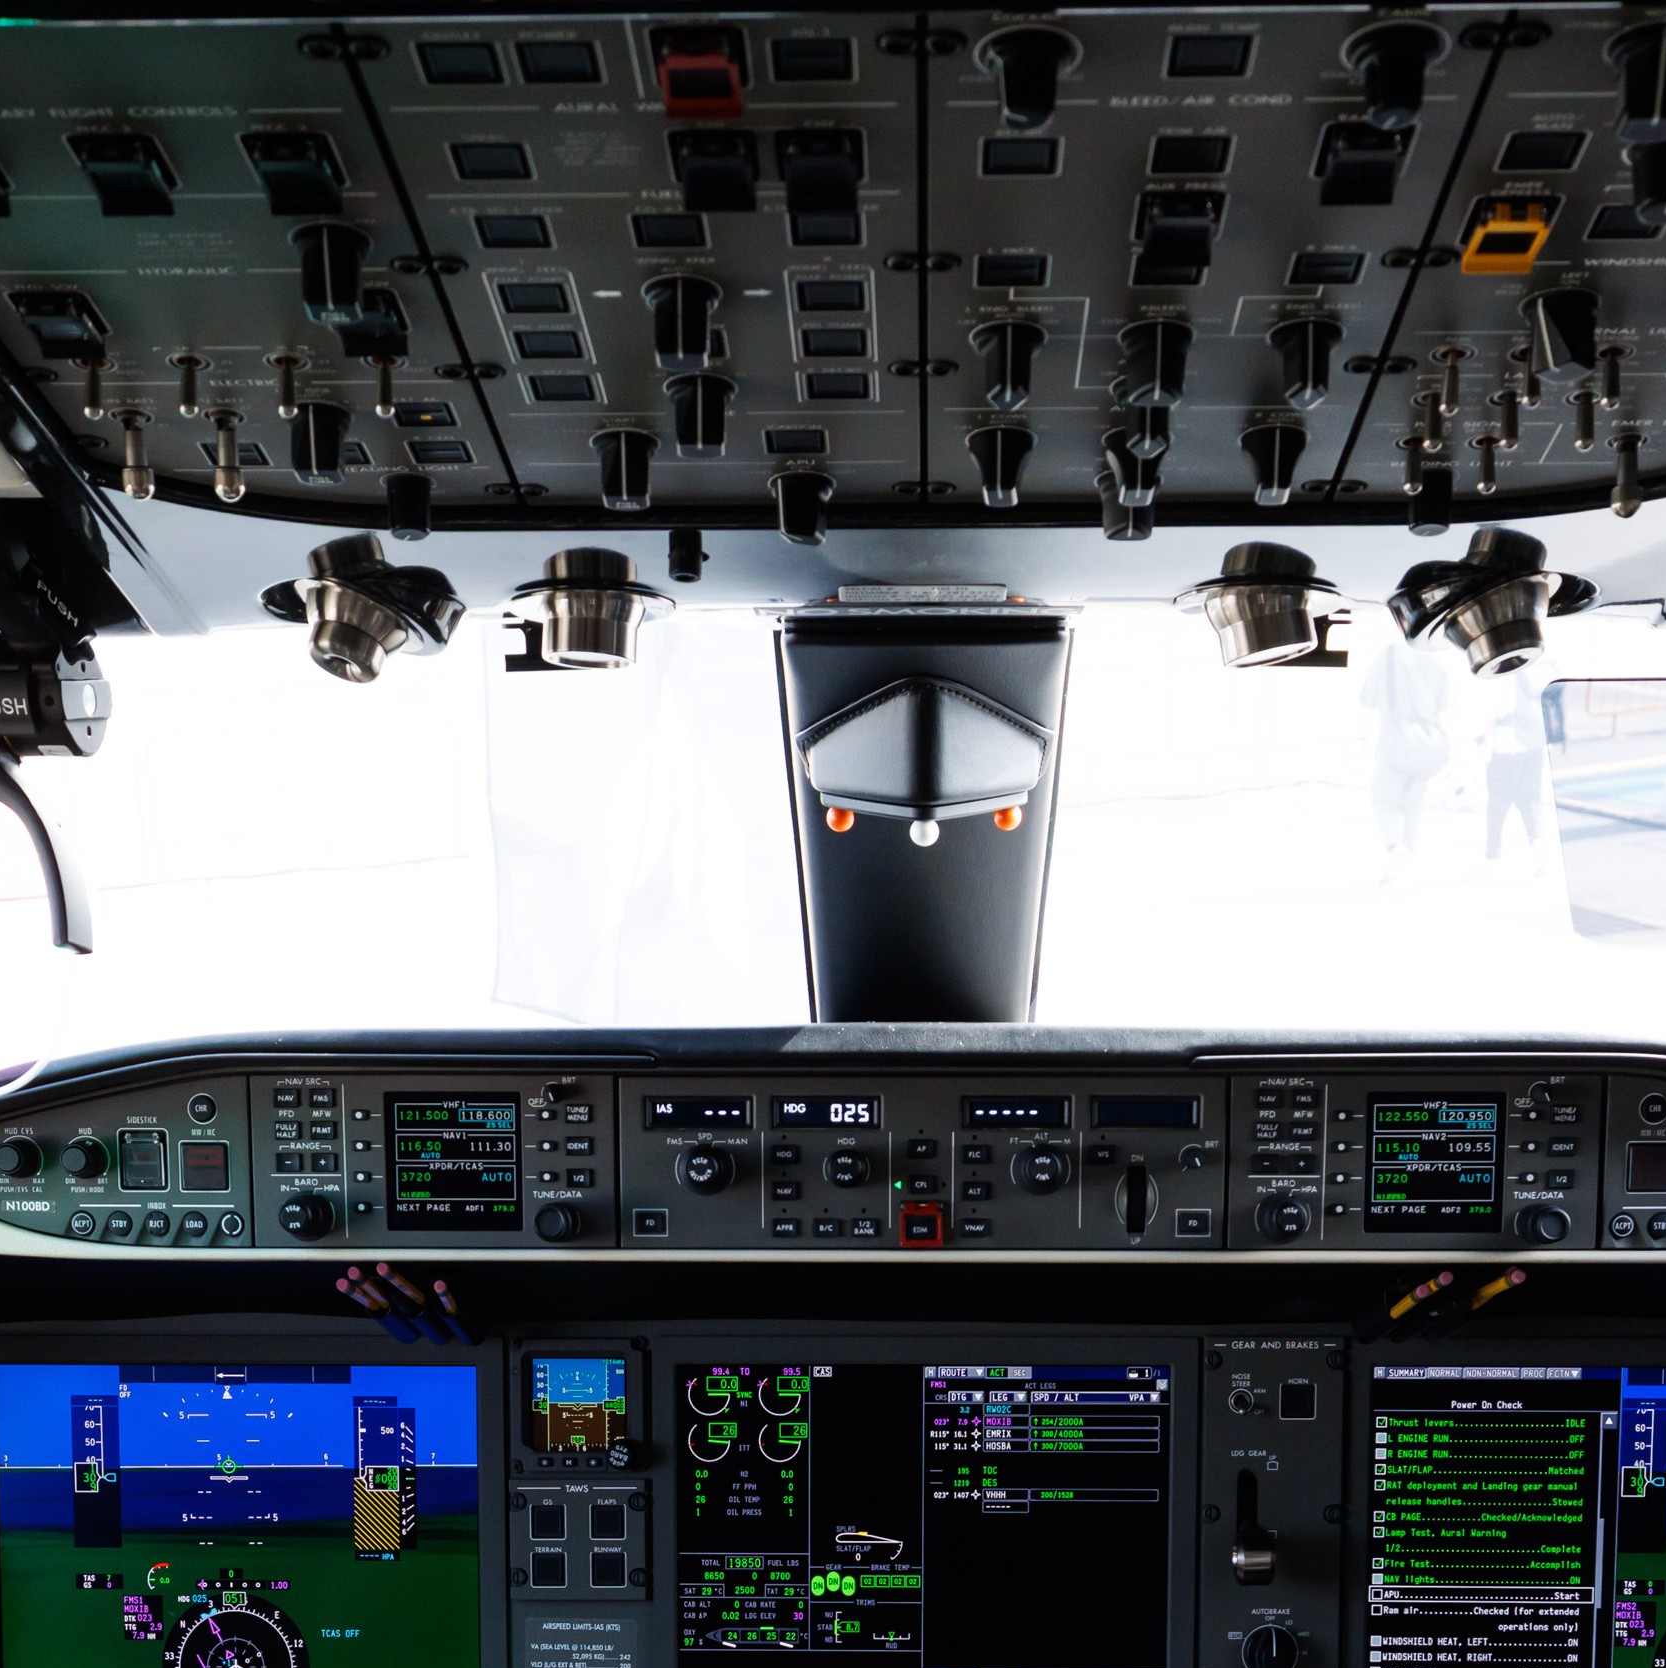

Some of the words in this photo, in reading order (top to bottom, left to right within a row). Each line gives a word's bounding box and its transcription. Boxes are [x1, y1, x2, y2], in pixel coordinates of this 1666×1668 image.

[37, 579, 79, 627] PUSH
[759, 607, 841, 616] NO
[847, 607, 1081, 616] SMOKING
[305, 1077, 322, 1086] SRC
[194, 1104, 208, 1113] CHR
[442, 1100, 467, 1109] VHF1
[656, 1103, 673, 1114] IAS
[278, 1109, 295, 1118] PFD
[400, 1110, 449, 1121] 121.500
[460, 1108, 511, 1122] 118.600
[783, 1103, 807, 1114] HDG
[830, 1103, 870, 1123] 025
[1379, 1111, 1429, 1122] 122.550
[1441, 1109, 1493, 1123] 120.950
[126, 1115, 158, 1124] SIDESTICK
[78, 1127, 93, 1136] HUD
[442, 1131, 467, 1140] NAV1
[697, 1132, 713, 1141] SPD
[288, 1141, 321, 1150] RANGE
[566, 1142, 589, 1150] IDENT
[837, 1137, 856, 1146] HDG
[400, 1141, 442, 1153] 116.50
[470, 1141, 512, 1152] 111.30
[428, 1161, 484, 1171] XPDR/TCAS
[401, 1171, 432, 1182] 3720
[481, 1171, 512, 1182] AUTO
[294, 1178, 319, 1187] BARO
[532, 1190, 583, 1199] TUNE/DATA
[6, 1200, 51, 1212] N100BD
[147, 1201, 167, 1210] INBOX
[396, 1203, 421, 1212] NEXT
[426, 1203, 451, 1212] PAGE
[73, 1219, 91, 1228] ACPT
[854, 1227, 874, 1235] BANK
[1231, 1340, 1256, 1350] GEAR
[1260, 1341, 1282, 1349] AND
[1285, 1340, 1320, 1350] BRAKES
[712, 1367, 730, 1376] 99.4
[739, 1367, 751, 1376] TO
[782, 1367, 801, 1376] 99.5
[815, 1367, 832, 1377] CAS
[940, 1368, 966, 1377] ROUTE
[1388, 1368, 1425, 1378] SUMMARY
[1429, 1367, 1462, 1378] NORMAL
[1466, 1369, 1517, 1378] NON-NORMAL
[1231, 1380, 1251, 1388] STEER
[1288, 1377, 1309, 1385] HORN
[736, 1391, 753, 1399] SYNC
[1450, 1400, 1478, 1410] Power
[1481, 1400, 1493, 1410] On
[1496, 1400, 1523, 1410] Check
[84, 1420, 95, 1429] 60
[986, 1417, 1012, 1427] MOXIB
[1041, 1417, 1084, 1427] 254/2000A
[986, 1429, 1012, 1438] EMRIX
[1041, 1429, 1084, 1439] 300/4000A
[985, 1441, 1012, 1451] HOSBA
[1041, 1441, 1084, 1453] 300/7000A
[1230, 1449, 1245, 1457] LDG
[565, 1484, 589, 1493] TAWS
[1387, 1481, 1402, 1490] RAT
[1406, 1481, 1457, 1492] deployment
[1462, 1482, 1477, 1491] and
[1482, 1482, 1518, 1492] Landing
[1522, 1484, 1543, 1492] gear
[1547, 1482, 1577, 1491] manual
[985, 1490, 1007, 1500] VHHH
[1040, 1490, 1074, 1500] 200/1528
[597, 1498, 617, 1506] FLAPS
[835, 1544, 872, 1553] SLAT/FLAP
[701, 1559, 721, 1567] TOTAL
[729, 1557, 761, 1568] 19850
[767, 1559, 784, 1567] FUEL
[786, 1559, 800, 1567] LBS
[734, 1585, 756, 1595] 2500
[123, 1595, 143, 1605] FMS1
[224, 1591, 245, 1606] 051
[123, 1604, 149, 1614] MOXIB
[1251, 1608, 1291, 1616] AUTOBRAKE
[605, 1623, 621, 1632] (KTS)
[321, 1629, 341, 1638] TCAS
[344, 1629, 360, 1638] OFF
